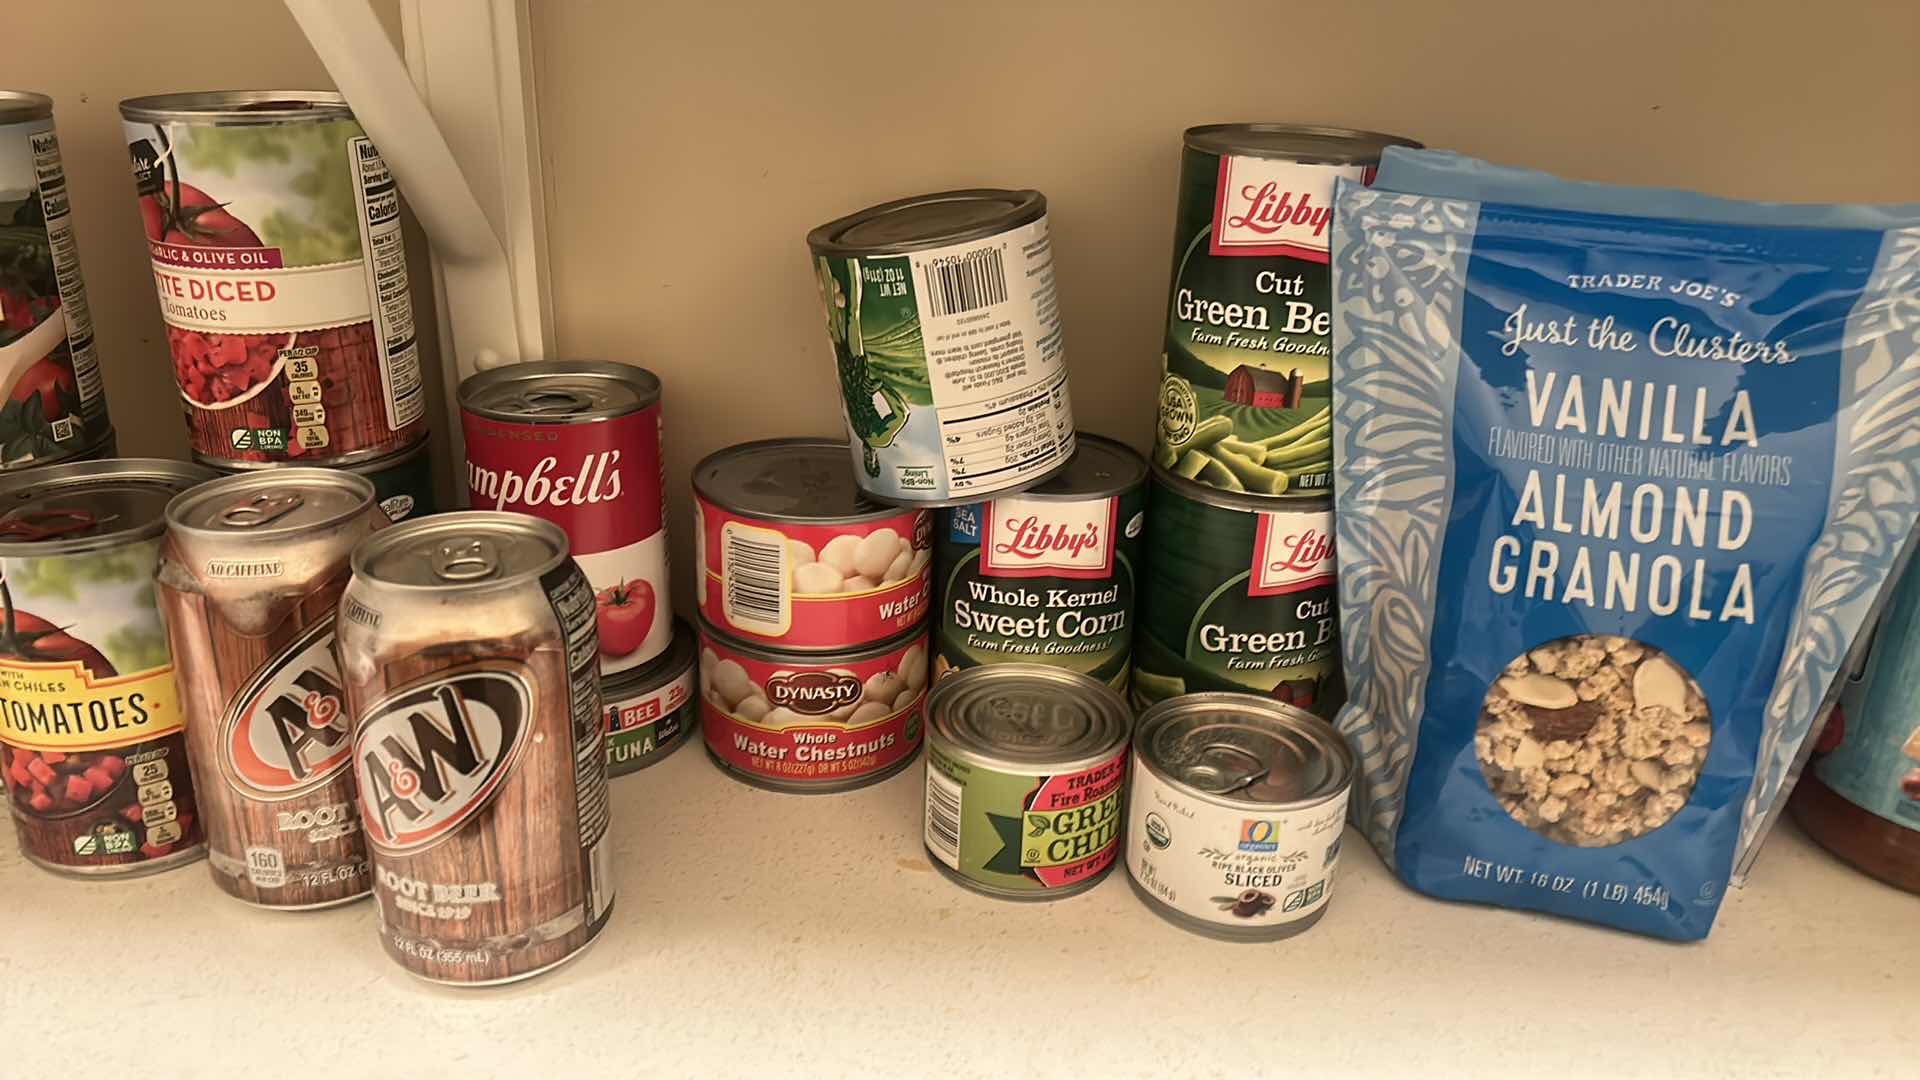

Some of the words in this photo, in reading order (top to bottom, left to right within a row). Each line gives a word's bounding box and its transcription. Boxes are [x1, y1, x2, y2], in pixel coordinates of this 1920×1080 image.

[182, 250, 190, 262] &
[193, 253, 236, 265] OLIVE
[240, 253, 269, 265] OIL
[966, 247, 993, 261] 20000
[884, 268, 895, 282] OZ
[895, 268, 905, 281] 11
[1255, 271, 1304, 296] Cut
[189, 279, 276, 302] DICED
[880, 283, 892, 297] WT
[892, 282, 907, 295] NET
[1567, 274, 1663, 290] TRADER
[1669, 279, 1742, 308] JOE'S
[162, 296, 228, 321] Tomatoes
[1177, 288, 1270, 331] Green
[1191, 327, 1222, 345] Farm
[1225, 332, 1268, 350] Fresh
[1273, 336, 1330, 357] Goodn
[1499, 303, 1578, 357] Just
[1587, 315, 1637, 352] the
[1649, 316, 1798, 365] Clusters
[294, 361, 308, 373] 35
[1526, 369, 1758, 447] VANILLA
[259, 437, 282, 445] BPA
[1488, 426, 1553, 464] FLAVORED
[1558, 435, 1593, 470] WITH
[1597, 442, 1643, 476] OTHER
[1649, 447, 1716, 480] NATURAL
[1722, 452, 1793, 486] FLAVORS
[955, 506, 976, 524] SEA
[1511, 469, 1753, 550] ALMOND
[953, 518, 977, 537] SALT
[996, 516, 1098, 560] Libby's
[210, 562, 224, 576] NO
[226, 562, 281, 577] CAFFEINE
[1488, 535, 1755, 624] GRANOLA
[879, 590, 920, 620] Water
[968, 581, 1039, 607] Whole
[1046, 584, 1118, 608] Kernel
[954, 600, 1050, 638] Sweet
[1056, 609, 1125, 639] Corn
[1296, 598, 1329, 620] Cut
[968, 634, 999, 651] Farm
[1002, 639, 1040, 655] Fresh
[1044, 637, 1113, 656] Goodness!
[1200, 624, 1306, 653] Green
[1314, 617, 1336, 646] B
[1227, 657, 1264, 670] Farm
[1268, 653, 1304, 670] Fresh
[14, 681, 66, 693] CHILES
[775, 683, 855, 701] DYNASTY
[0, 693, 149, 735] TOMATOES
[624, 703, 655, 727] BEE
[733, 733, 788, 761] Water
[795, 733, 896, 762] Chestnuts
[793, 733, 837, 745] Whole
[606, 737, 653, 765] TUNA
[143, 764, 158, 777] 25
[364, 685, 490, 844] A&W
[1051, 792, 1080, 807] Fire
[1248, 820, 1272, 842] O
[251, 852, 278, 868] 160
[1063, 866, 1083, 878] NET
[1224, 873, 1282, 888] SLICED
[1463, 855, 1492, 880] NET
[1530, 872, 1548, 888] 16
[1552, 875, 1575, 894] OZ
[1583, 879, 1600, 898] (1
[1603, 882, 1627, 905] LB)
[1632, 885, 1670, 912] 454g
[377, 864, 429, 901] ROOT
[432, 881, 501, 904] BEER
[405, 942, 417, 956] FL
[419, 945, 434, 960] OZ
[466, 951, 489, 966] mL)
